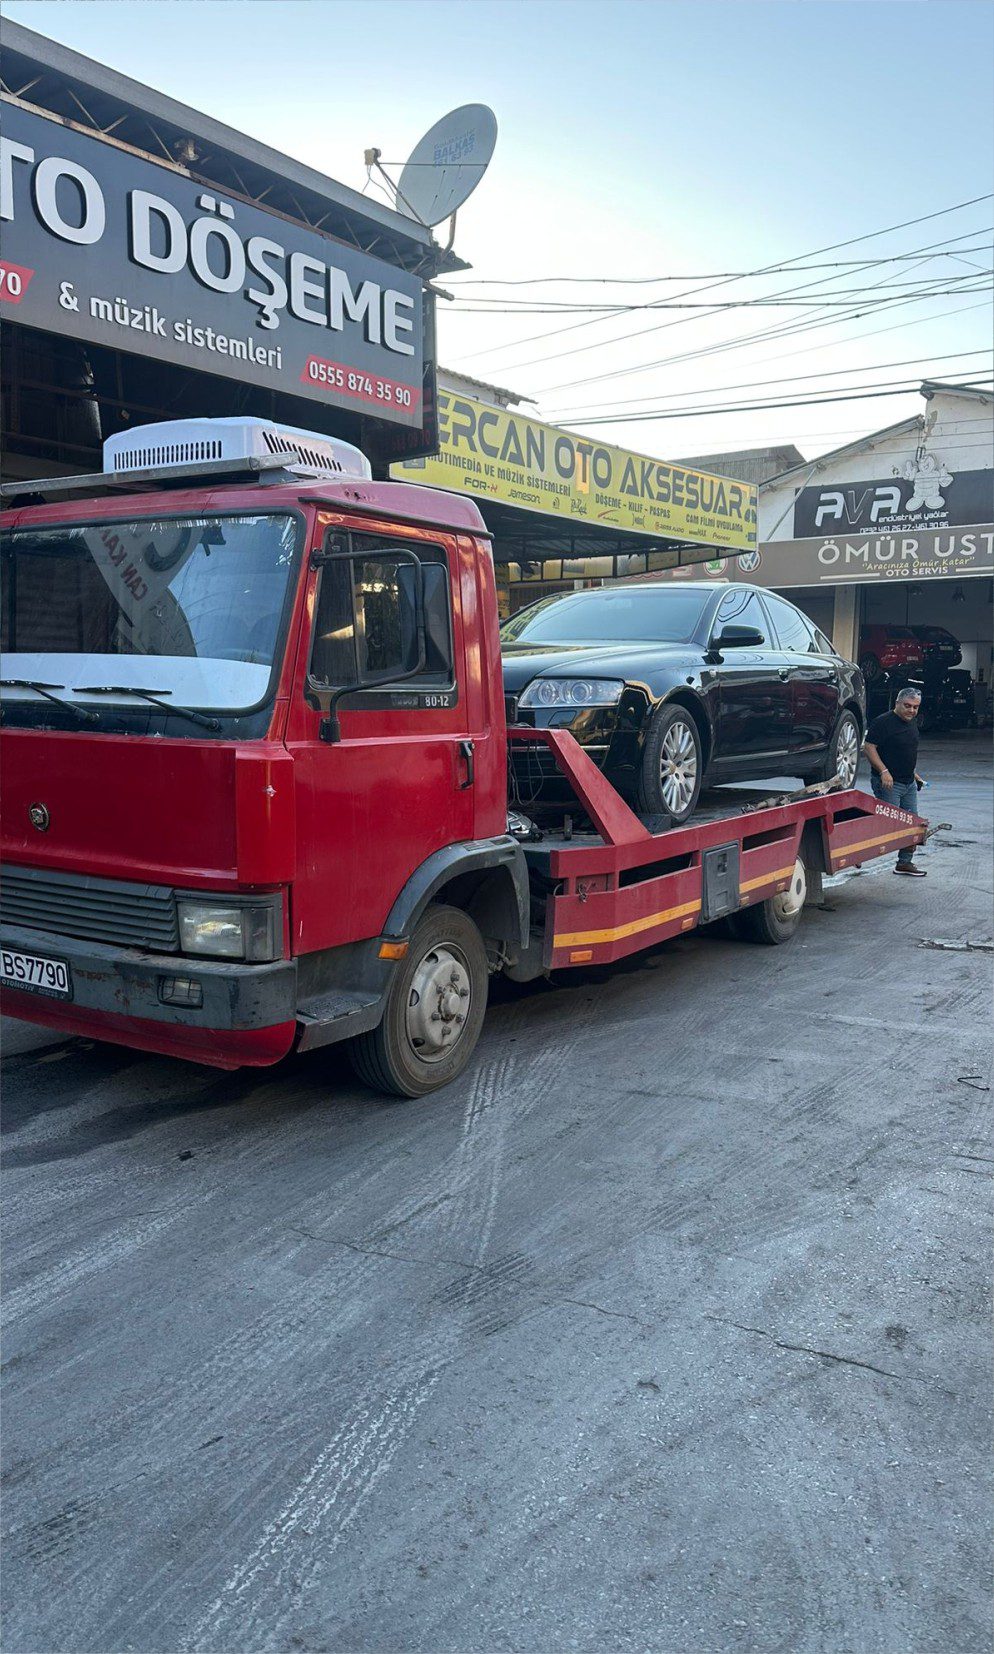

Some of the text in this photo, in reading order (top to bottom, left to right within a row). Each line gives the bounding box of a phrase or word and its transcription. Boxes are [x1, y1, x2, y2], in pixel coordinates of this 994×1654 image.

[0, 268, 21, 295] 0
[131, 193, 415, 357] DÖŞEME
[58, 280, 283, 370] & müzik sistemleri
[308, 360, 411, 407] 0555 874 35 90
[484, 463, 495, 476] VE
[497, 467, 525, 485] MÜZİK
[526, 474, 571, 497] SİSTEMLERİ
[553, 435, 612, 489] OTO
[619, 456, 743, 519] AKSESUAR
[649, 505, 671, 519] PASPAS
[814, 486, 901, 527] AVA
[878, 512, 922, 523] endüstriyel
[817, 535, 919, 565] ÖMÜR
[912, 559, 939, 569] Ömür
[886, 565, 948, 577] OTO SERVİS
[875, 804, 890, 817] 0542
